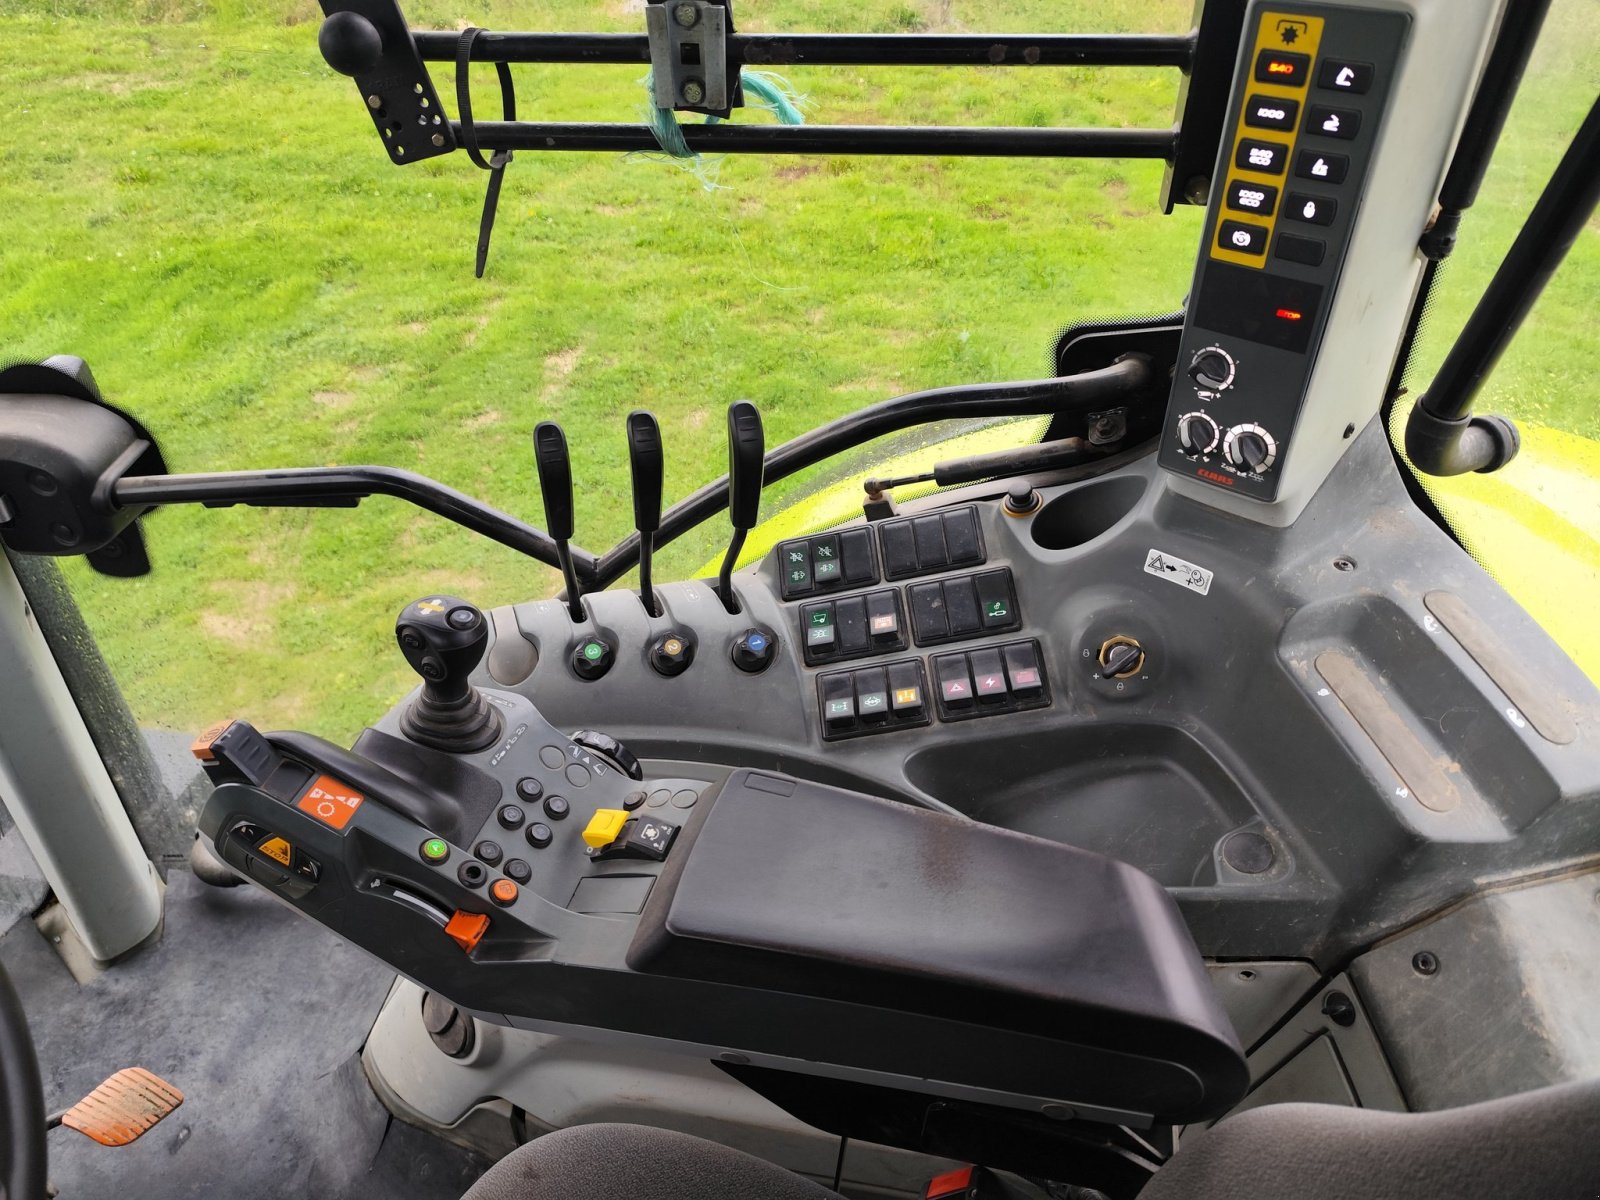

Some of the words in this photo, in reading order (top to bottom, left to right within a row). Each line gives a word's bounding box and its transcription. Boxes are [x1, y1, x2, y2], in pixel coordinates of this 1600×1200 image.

[1269, 62, 1293, 74] 540
[1257, 107, 1285, 119] 1000
[1239, 189, 1264, 200] 1000
[1276, 309, 1301, 319] STOP
[1197, 468, 1233, 485] CLAAS
[668, 643, 678, 652] 2
